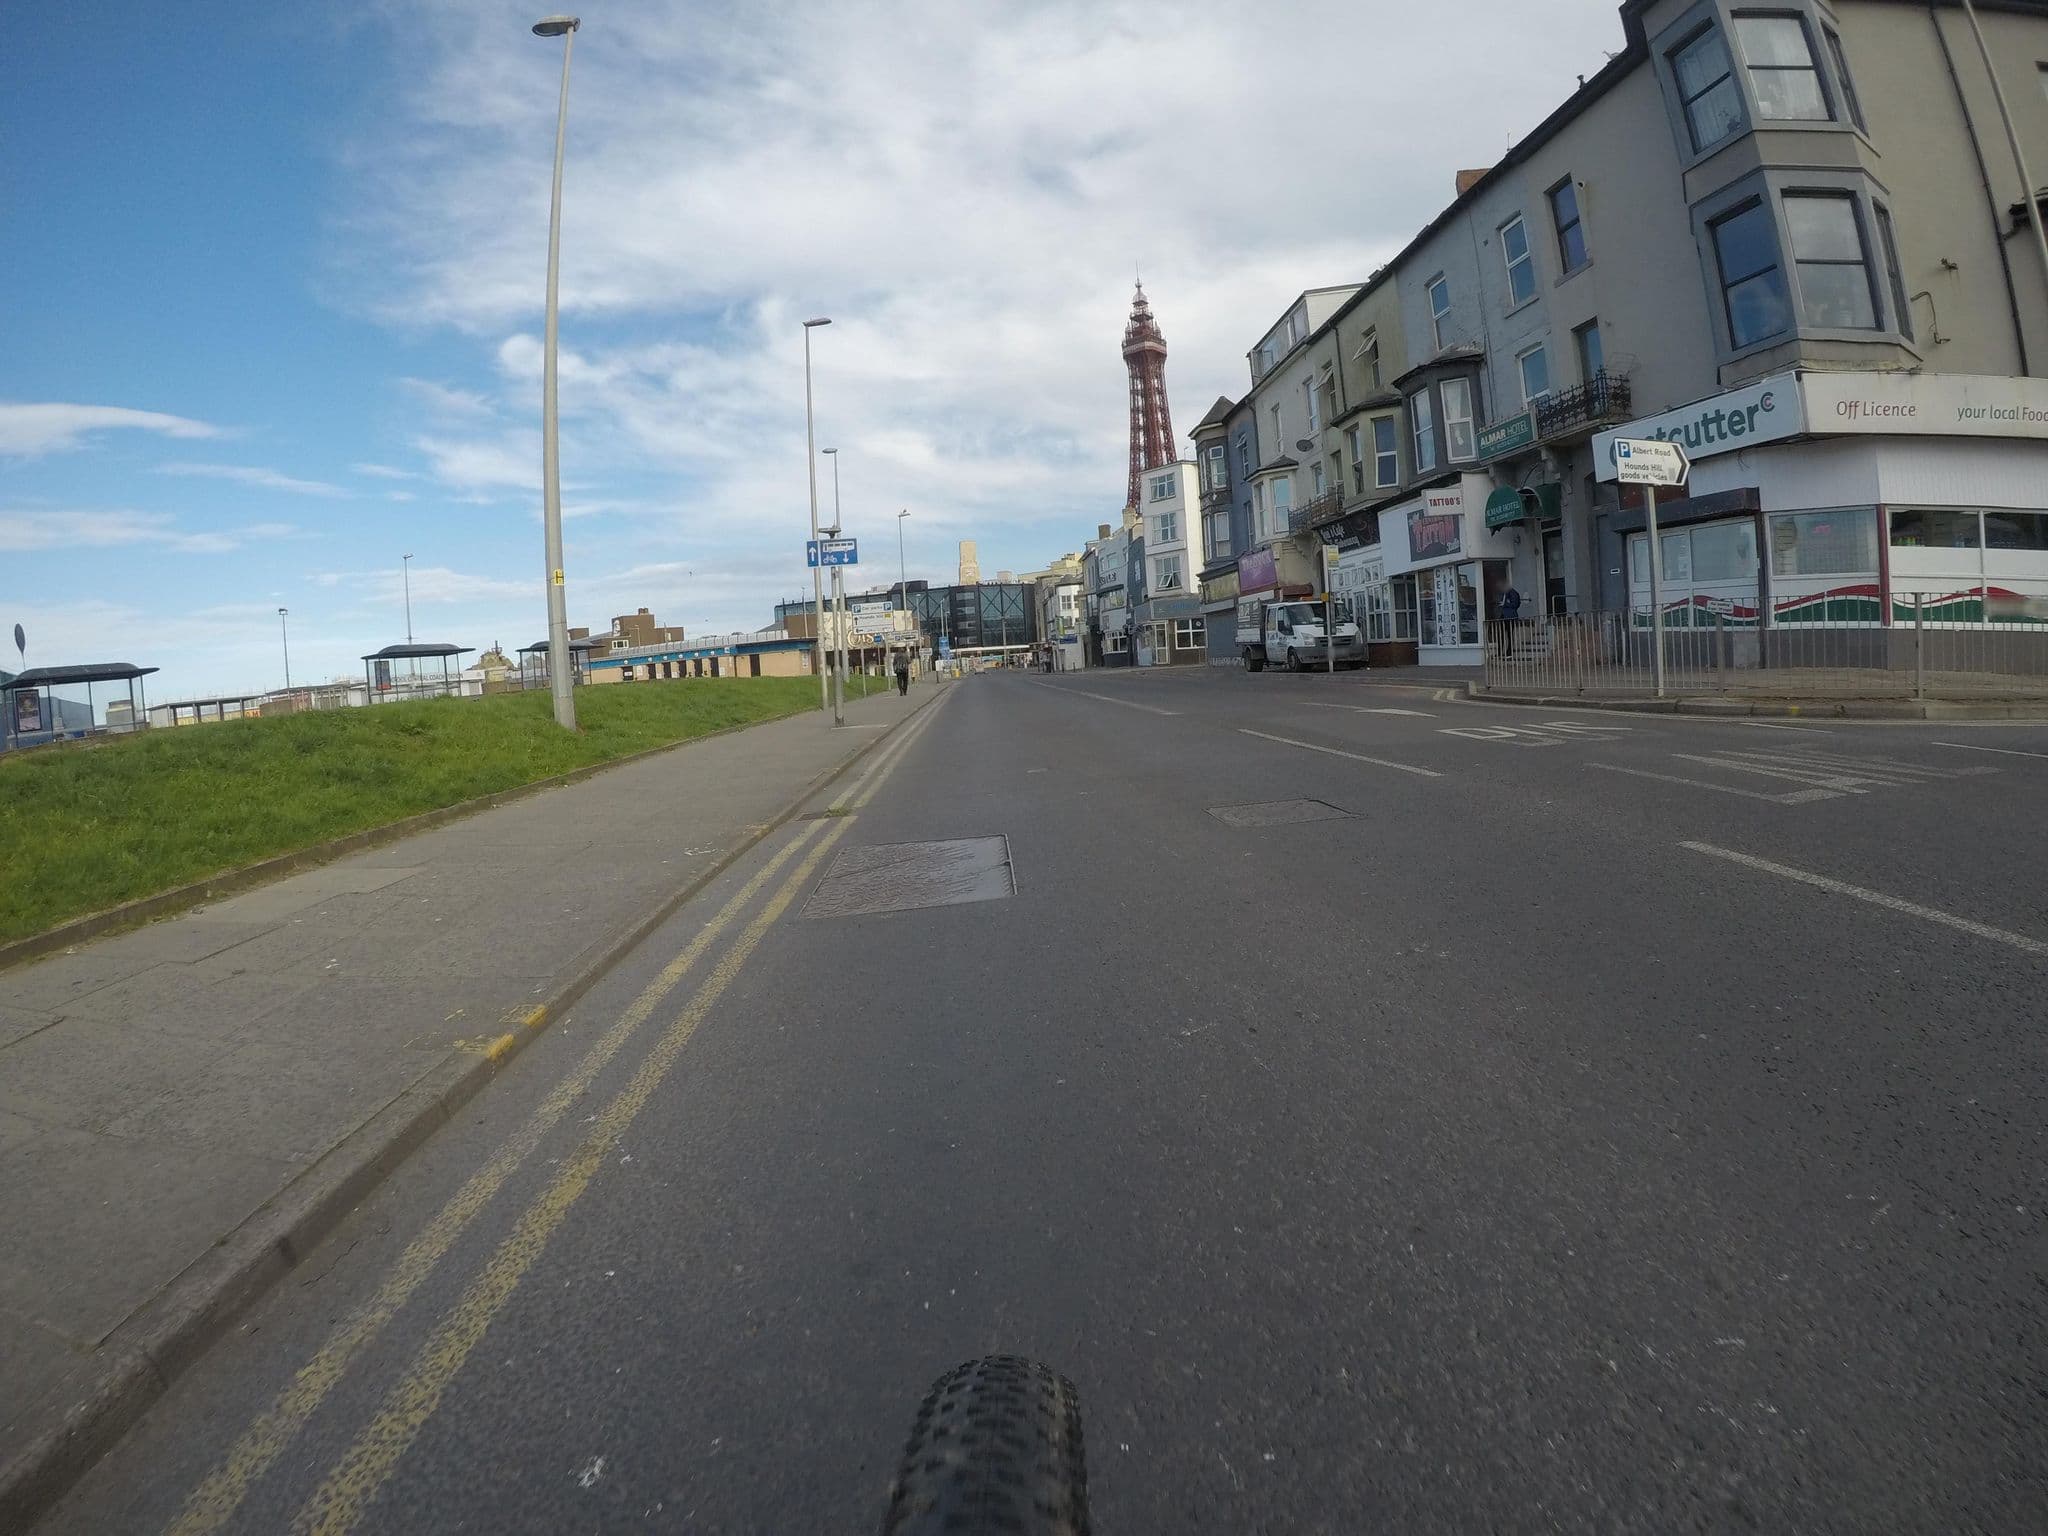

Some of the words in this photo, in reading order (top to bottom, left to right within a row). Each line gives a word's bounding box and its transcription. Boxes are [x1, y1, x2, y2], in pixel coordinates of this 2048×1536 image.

[1836, 401, 1860, 419] Off
[1862, 401, 1916, 417] Licence
[1957, 406, 1986, 421] your
[1989, 405, 2019, 420] local
[1480, 429, 1506, 446] ALMAR
[1506, 420, 1529, 435] HOTEL
[1632, 446, 1653, 456] Albert
[1655, 448, 1671, 456] Road
[1624, 463, 1649, 471] Hounds
[1620, 472, 1640, 480] goods
[1642, 473, 1668, 481] vecles
[1429, 497, 1460, 507] TATTOO'S
[1435, 568, 1445, 647] CENTRAL
[1448, 567, 1458, 646] TATTOOS
